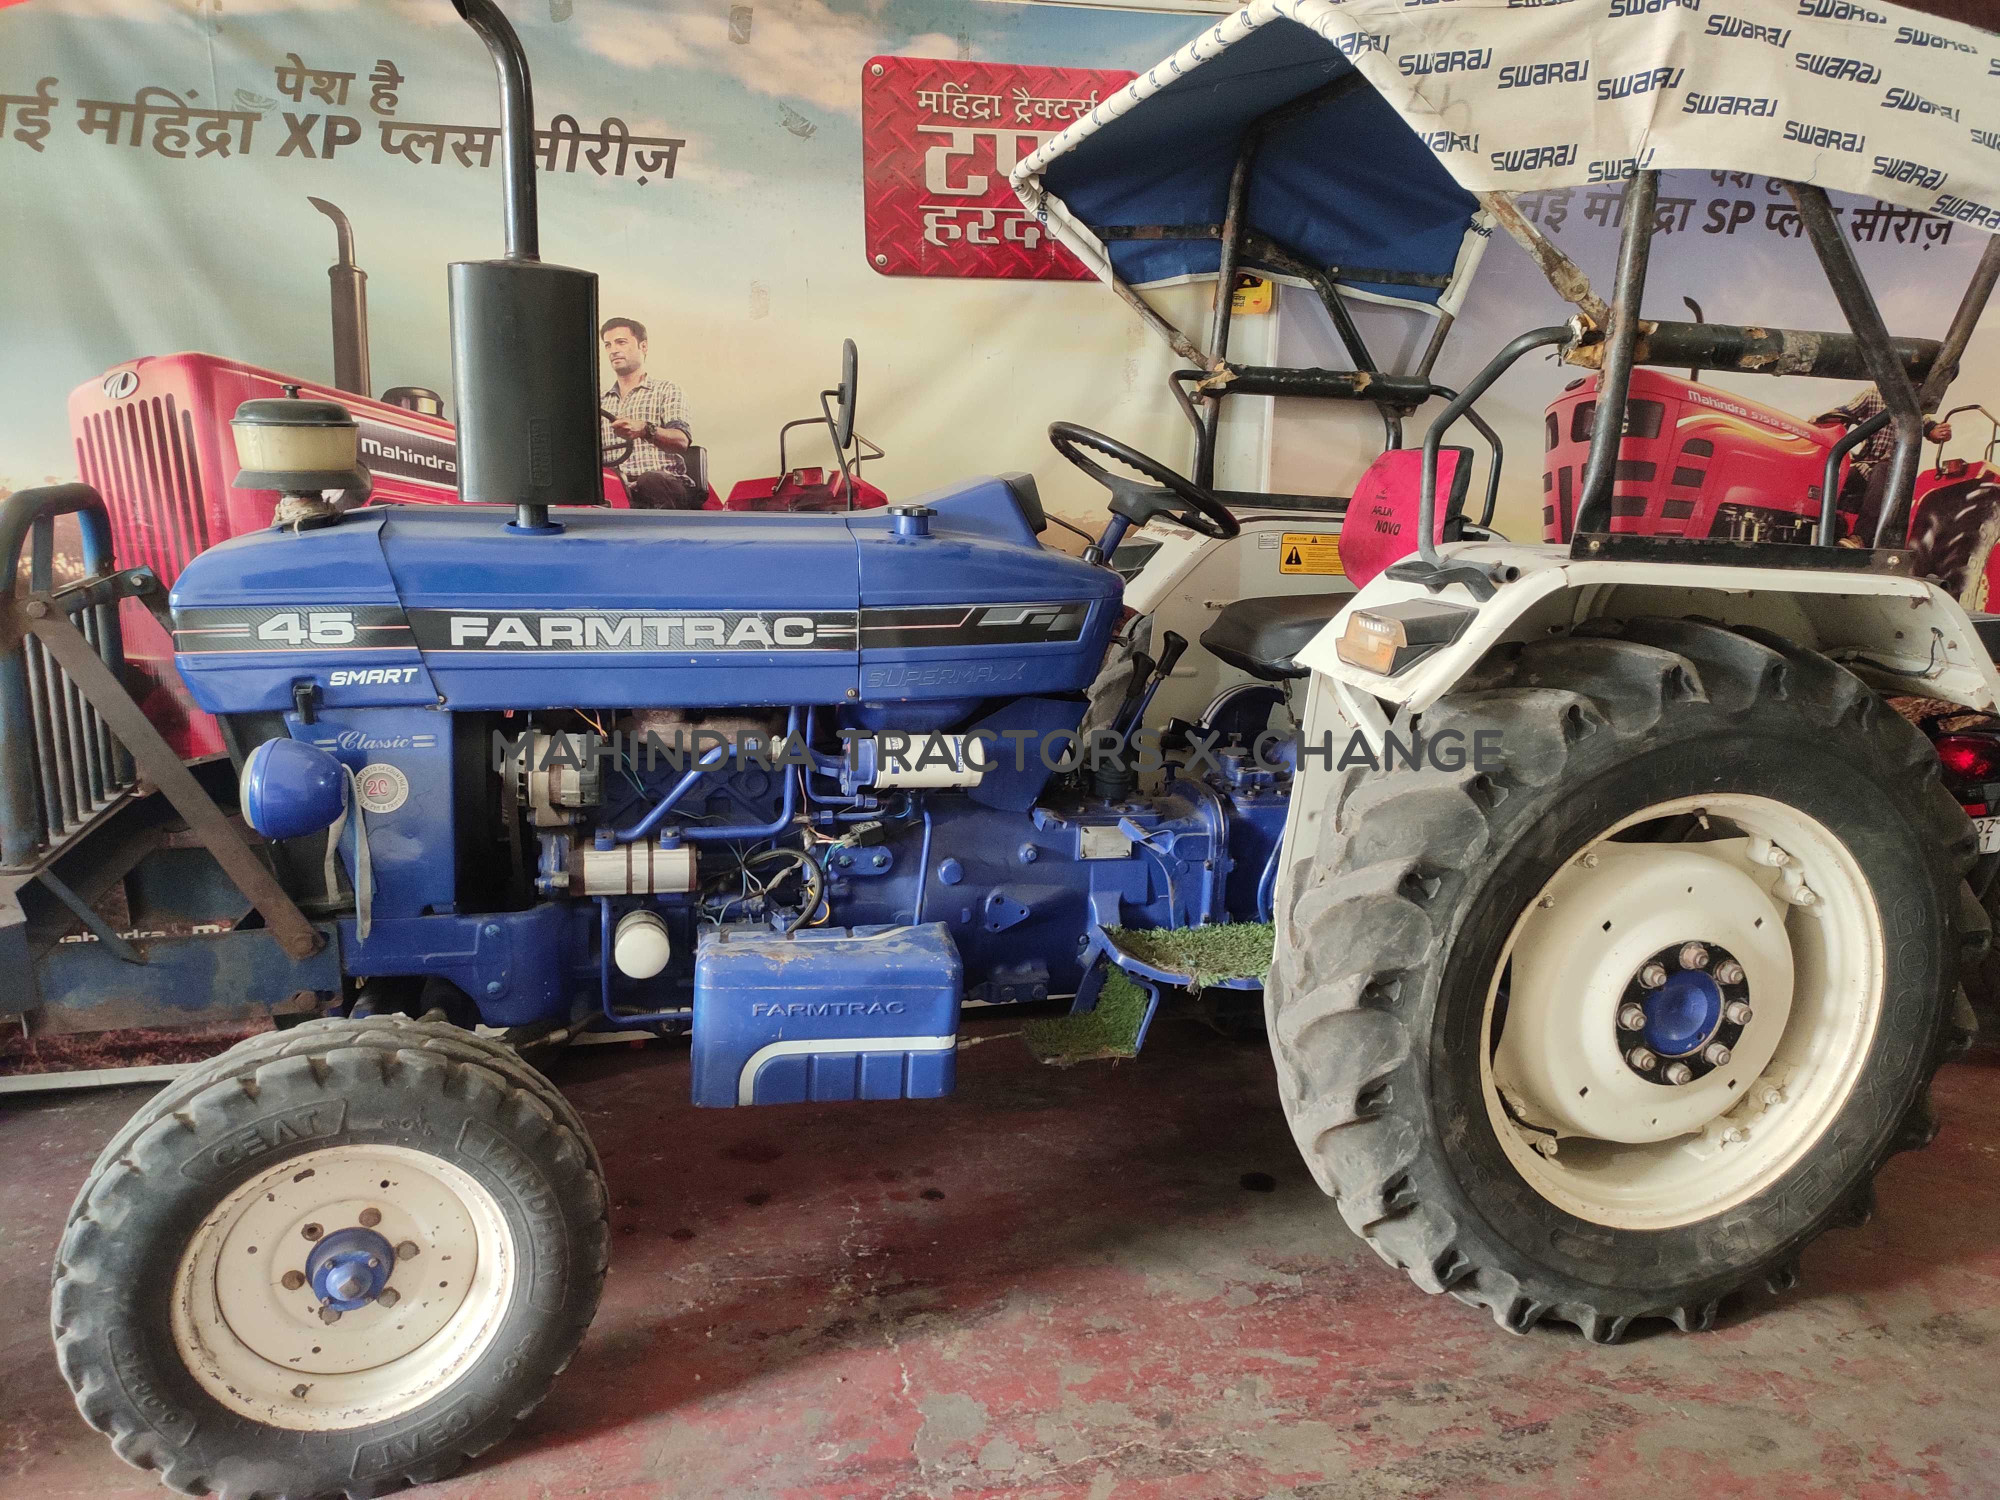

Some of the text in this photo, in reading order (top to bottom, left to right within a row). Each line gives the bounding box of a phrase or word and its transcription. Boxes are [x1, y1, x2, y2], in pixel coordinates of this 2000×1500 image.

[274, 53, 405, 116] पेश है
[917, 82, 1003, 120] महिंद्रा
[76, 86, 262, 159] महिंद्रा
[275, 112, 362, 160] XP
[379, 121, 501, 169] प्लस
[1702, 198, 1756, 235] SP
[1374, 520, 1402, 536] NOVO
[256, 612, 356, 645] 45
[450, 616, 815, 648] FARMTRAC
[329, 667, 419, 687] SMART
[336, 730, 412, 752] Classic
[752, 1000, 906, 1018] FARMTRAC
[213, 1109, 317, 1166] CEAT
[380, 1409, 470, 1469] CEAT
